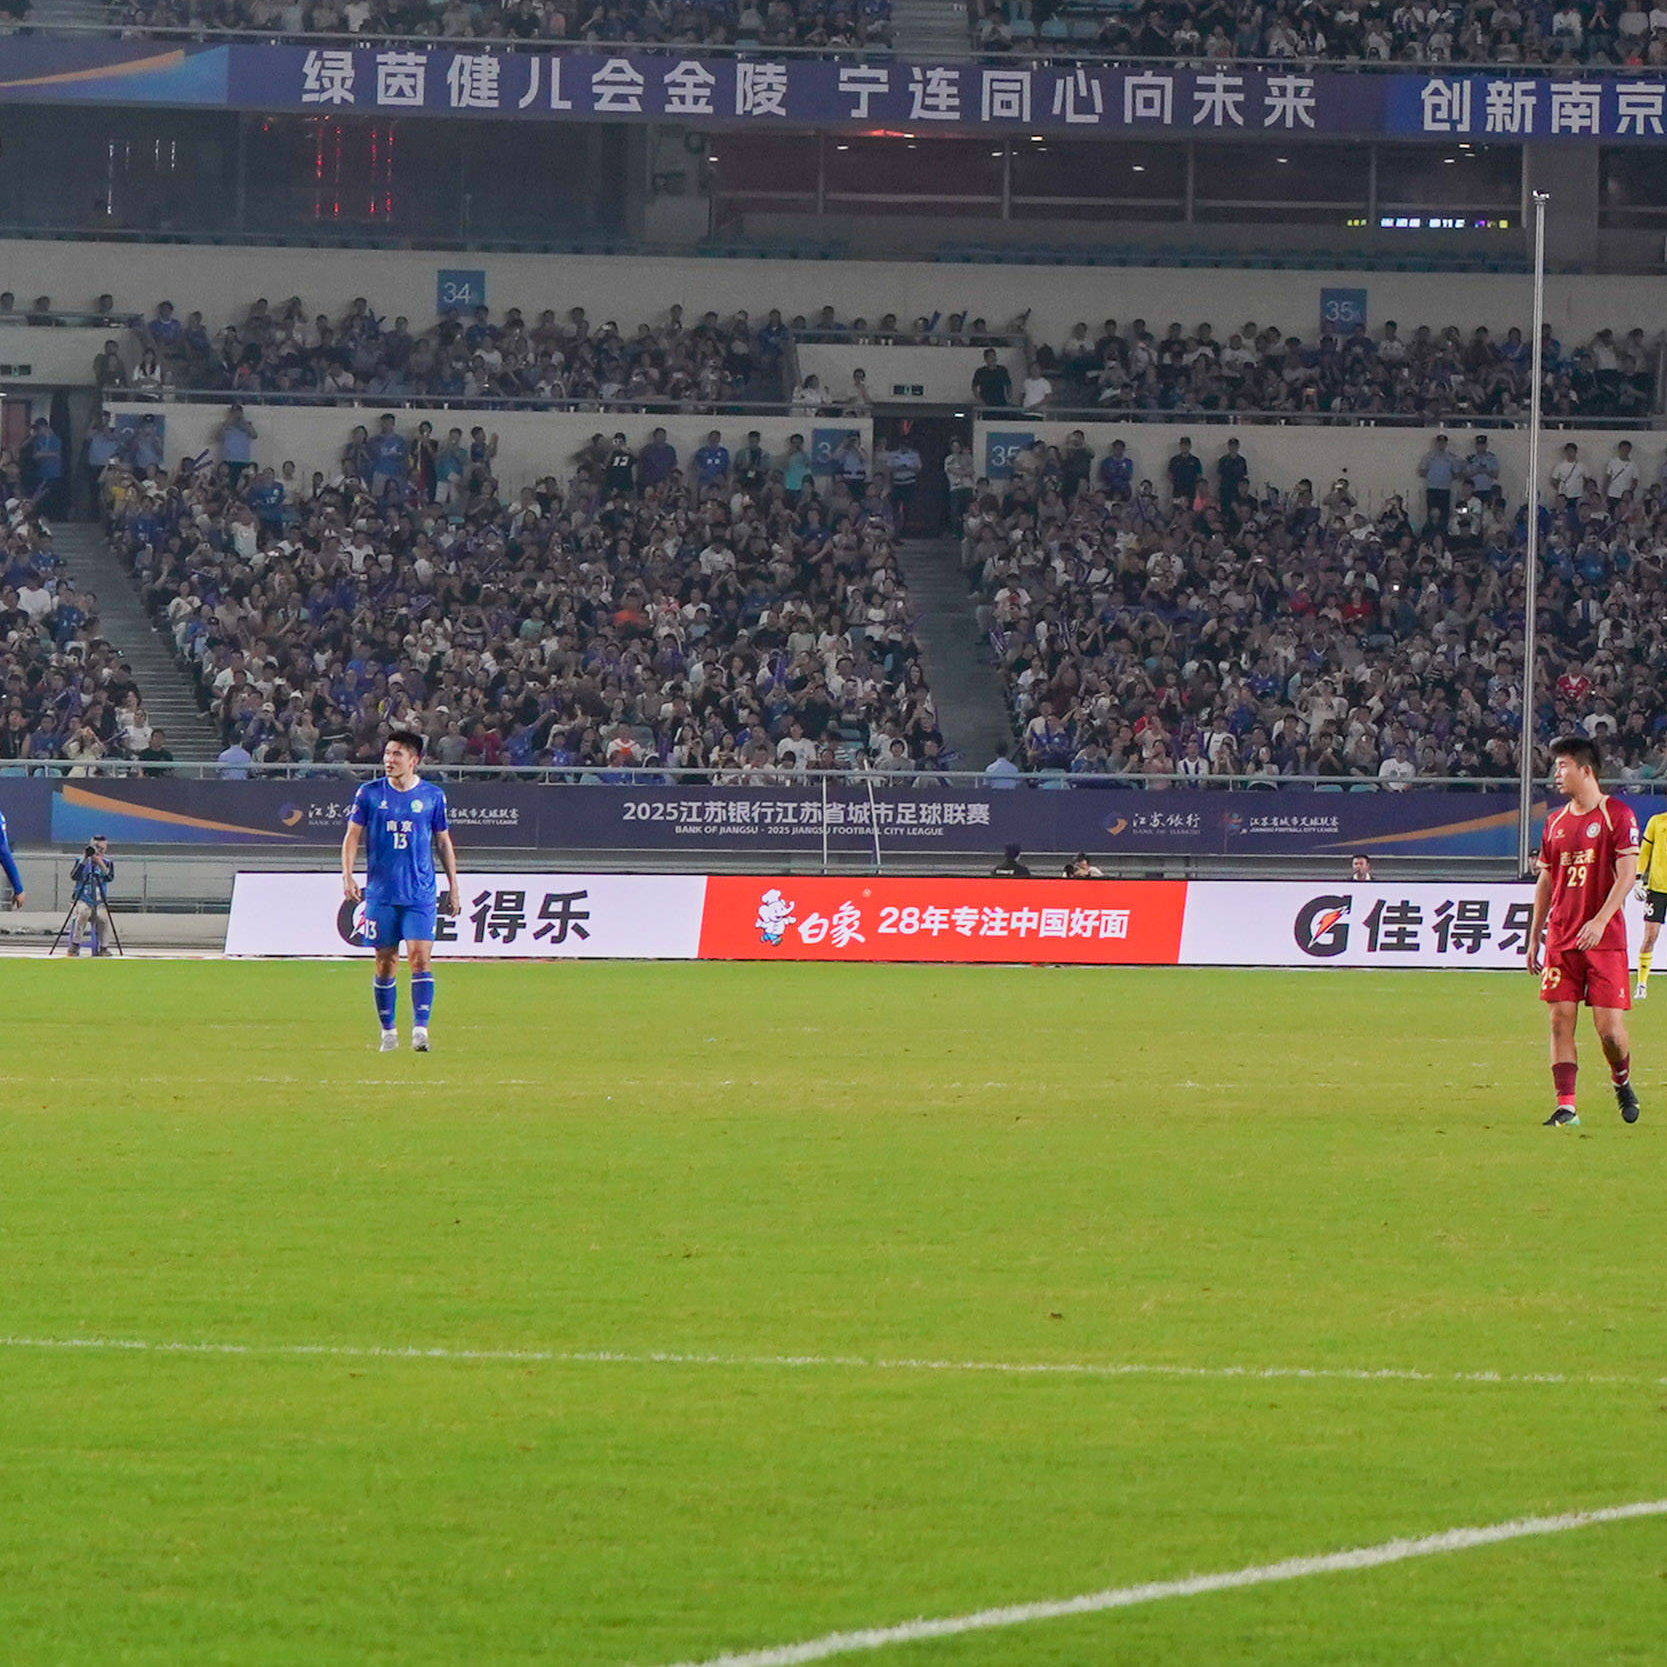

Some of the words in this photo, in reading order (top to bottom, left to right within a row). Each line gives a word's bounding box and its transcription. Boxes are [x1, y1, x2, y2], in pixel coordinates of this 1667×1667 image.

[302, 50, 787, 117] 绿茵健儿会金陵
[838, 65, 1316, 128] 宁连同心向未来
[1421, 80, 1666, 135] 创新南京
[622, 800, 990, 826] 2025江苏银行江苏省城市足球联赛
[393, 833, 408, 850] 13
[675, 825, 703, 834] BANK
[704, 825, 717, 834] OF
[767, 826, 790, 835] 2025
[1567, 866, 1588, 888] 29
[364, 918, 377, 940] 13
[797, 900, 866, 948] 白象
[877, 905, 1130, 940] 28年专注中国好面
